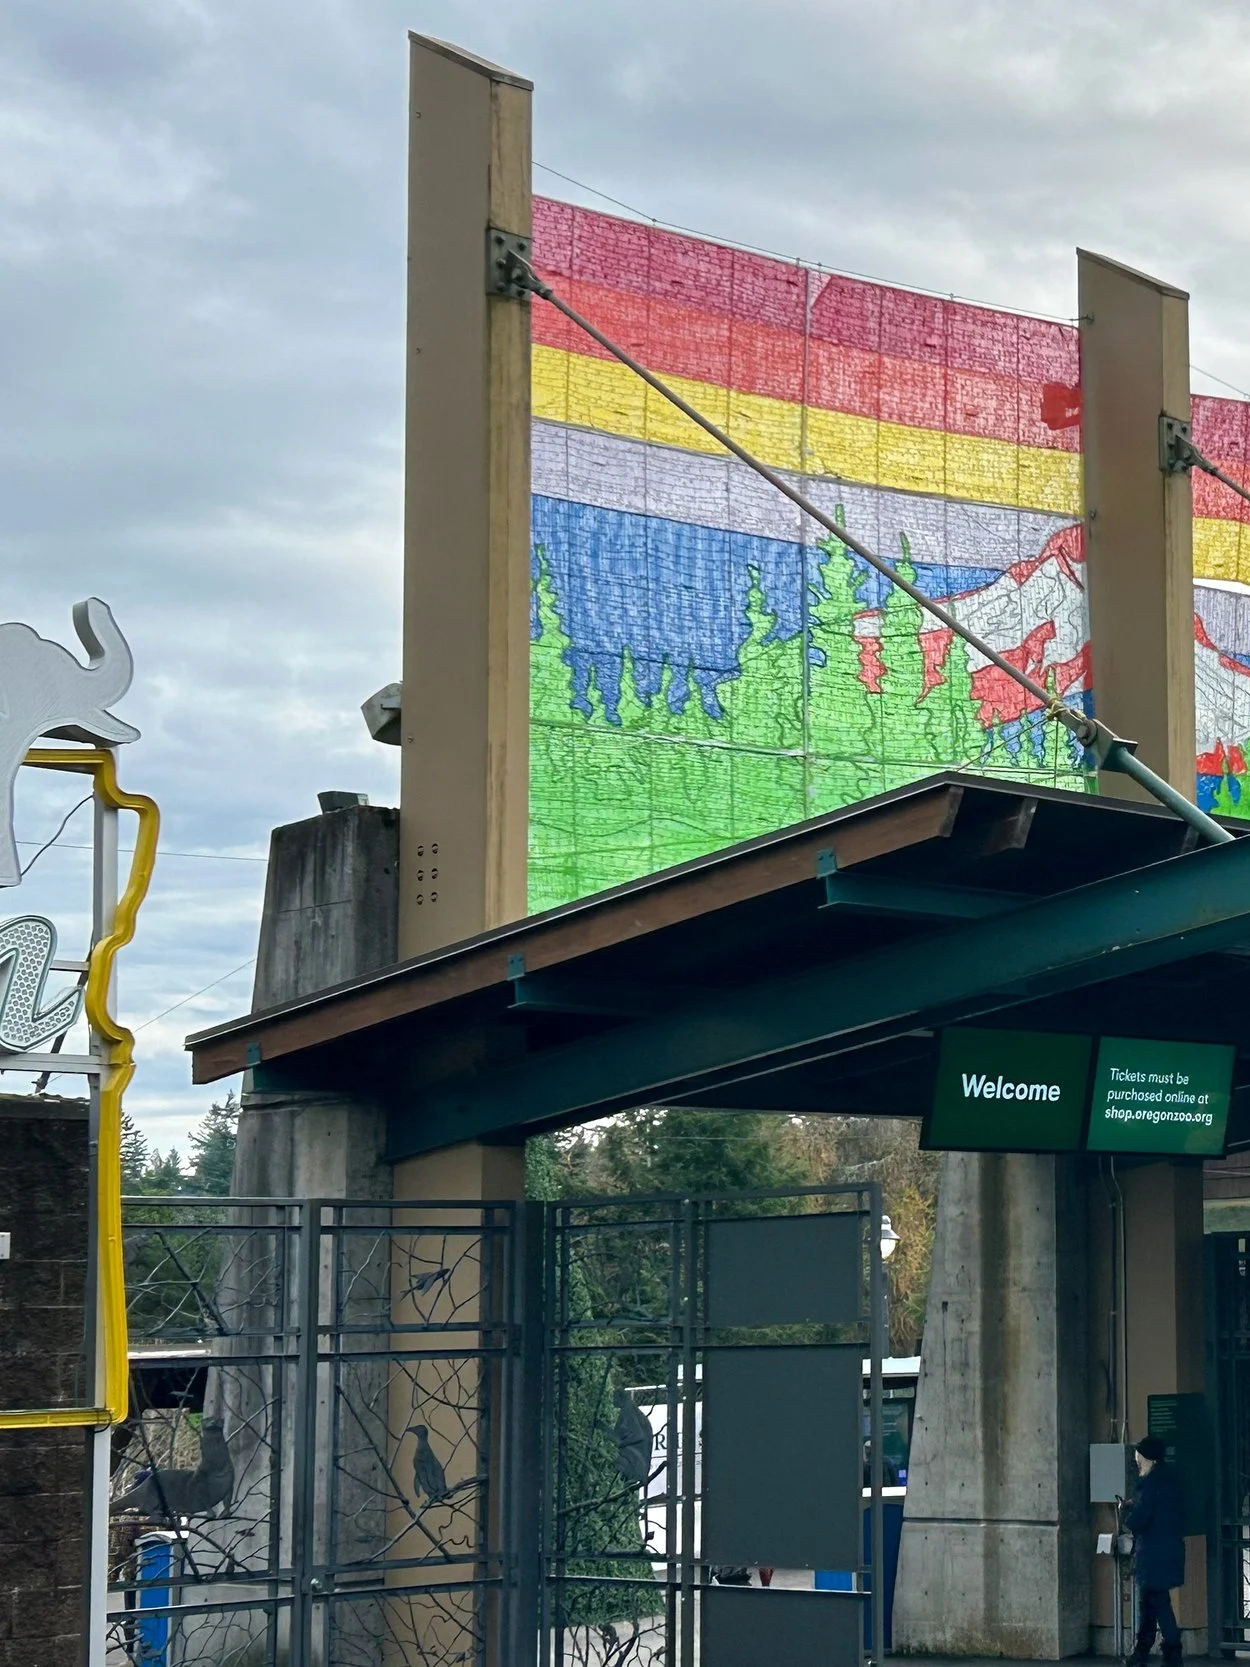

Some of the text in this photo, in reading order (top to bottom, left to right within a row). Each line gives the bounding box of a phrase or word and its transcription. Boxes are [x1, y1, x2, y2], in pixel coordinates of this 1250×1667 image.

[1110, 1068, 1189, 1085] Tickets must be
[961, 1073, 1061, 1102] Welcome
[1107, 1088, 1209, 1105] purchased online at
[1105, 1105, 1213, 1126] shop.oregonzoo.org
